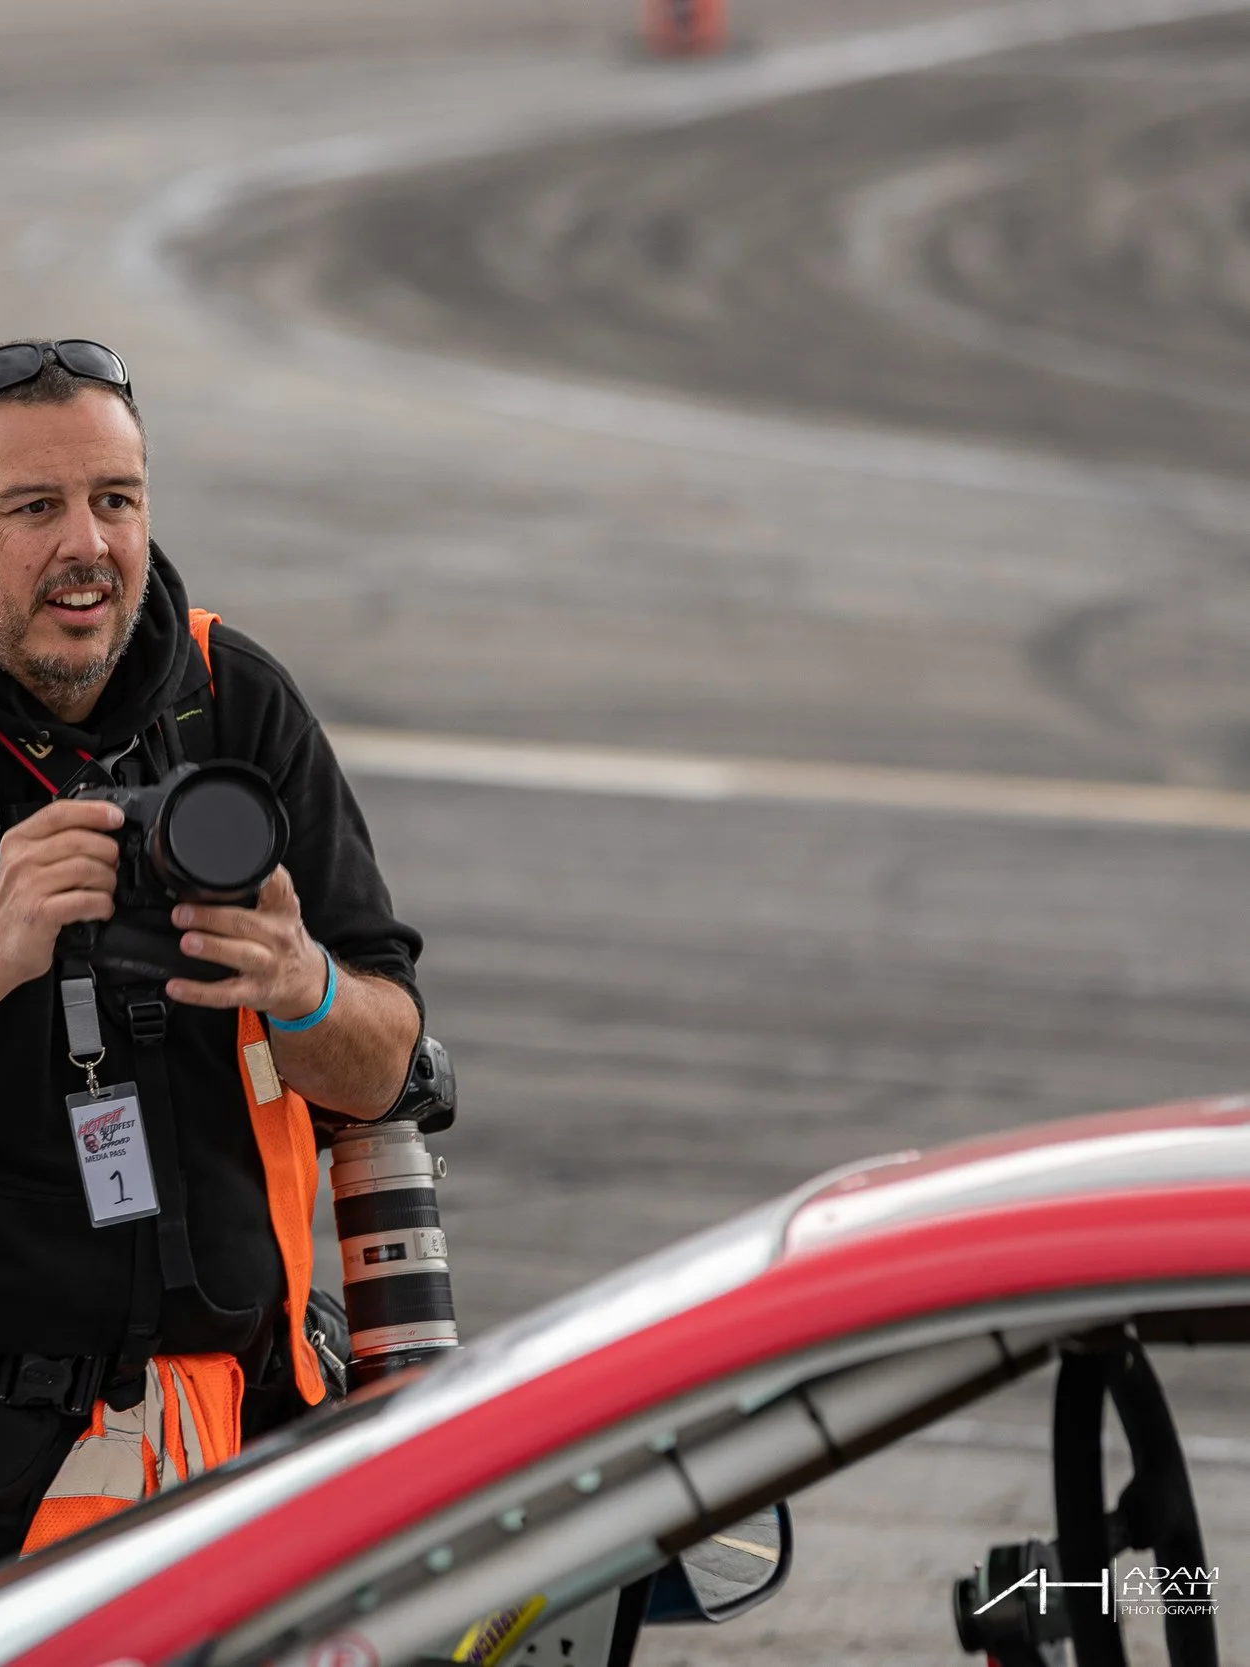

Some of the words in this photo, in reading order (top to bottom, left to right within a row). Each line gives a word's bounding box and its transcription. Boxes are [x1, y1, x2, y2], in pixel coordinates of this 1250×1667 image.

[100, 1120, 135, 1134] AUTOFEST
[85, 1152, 109, 1163] MEDIA
[110, 1148, 126, 1158] PASS
[110, 1170, 133, 1204] 1
